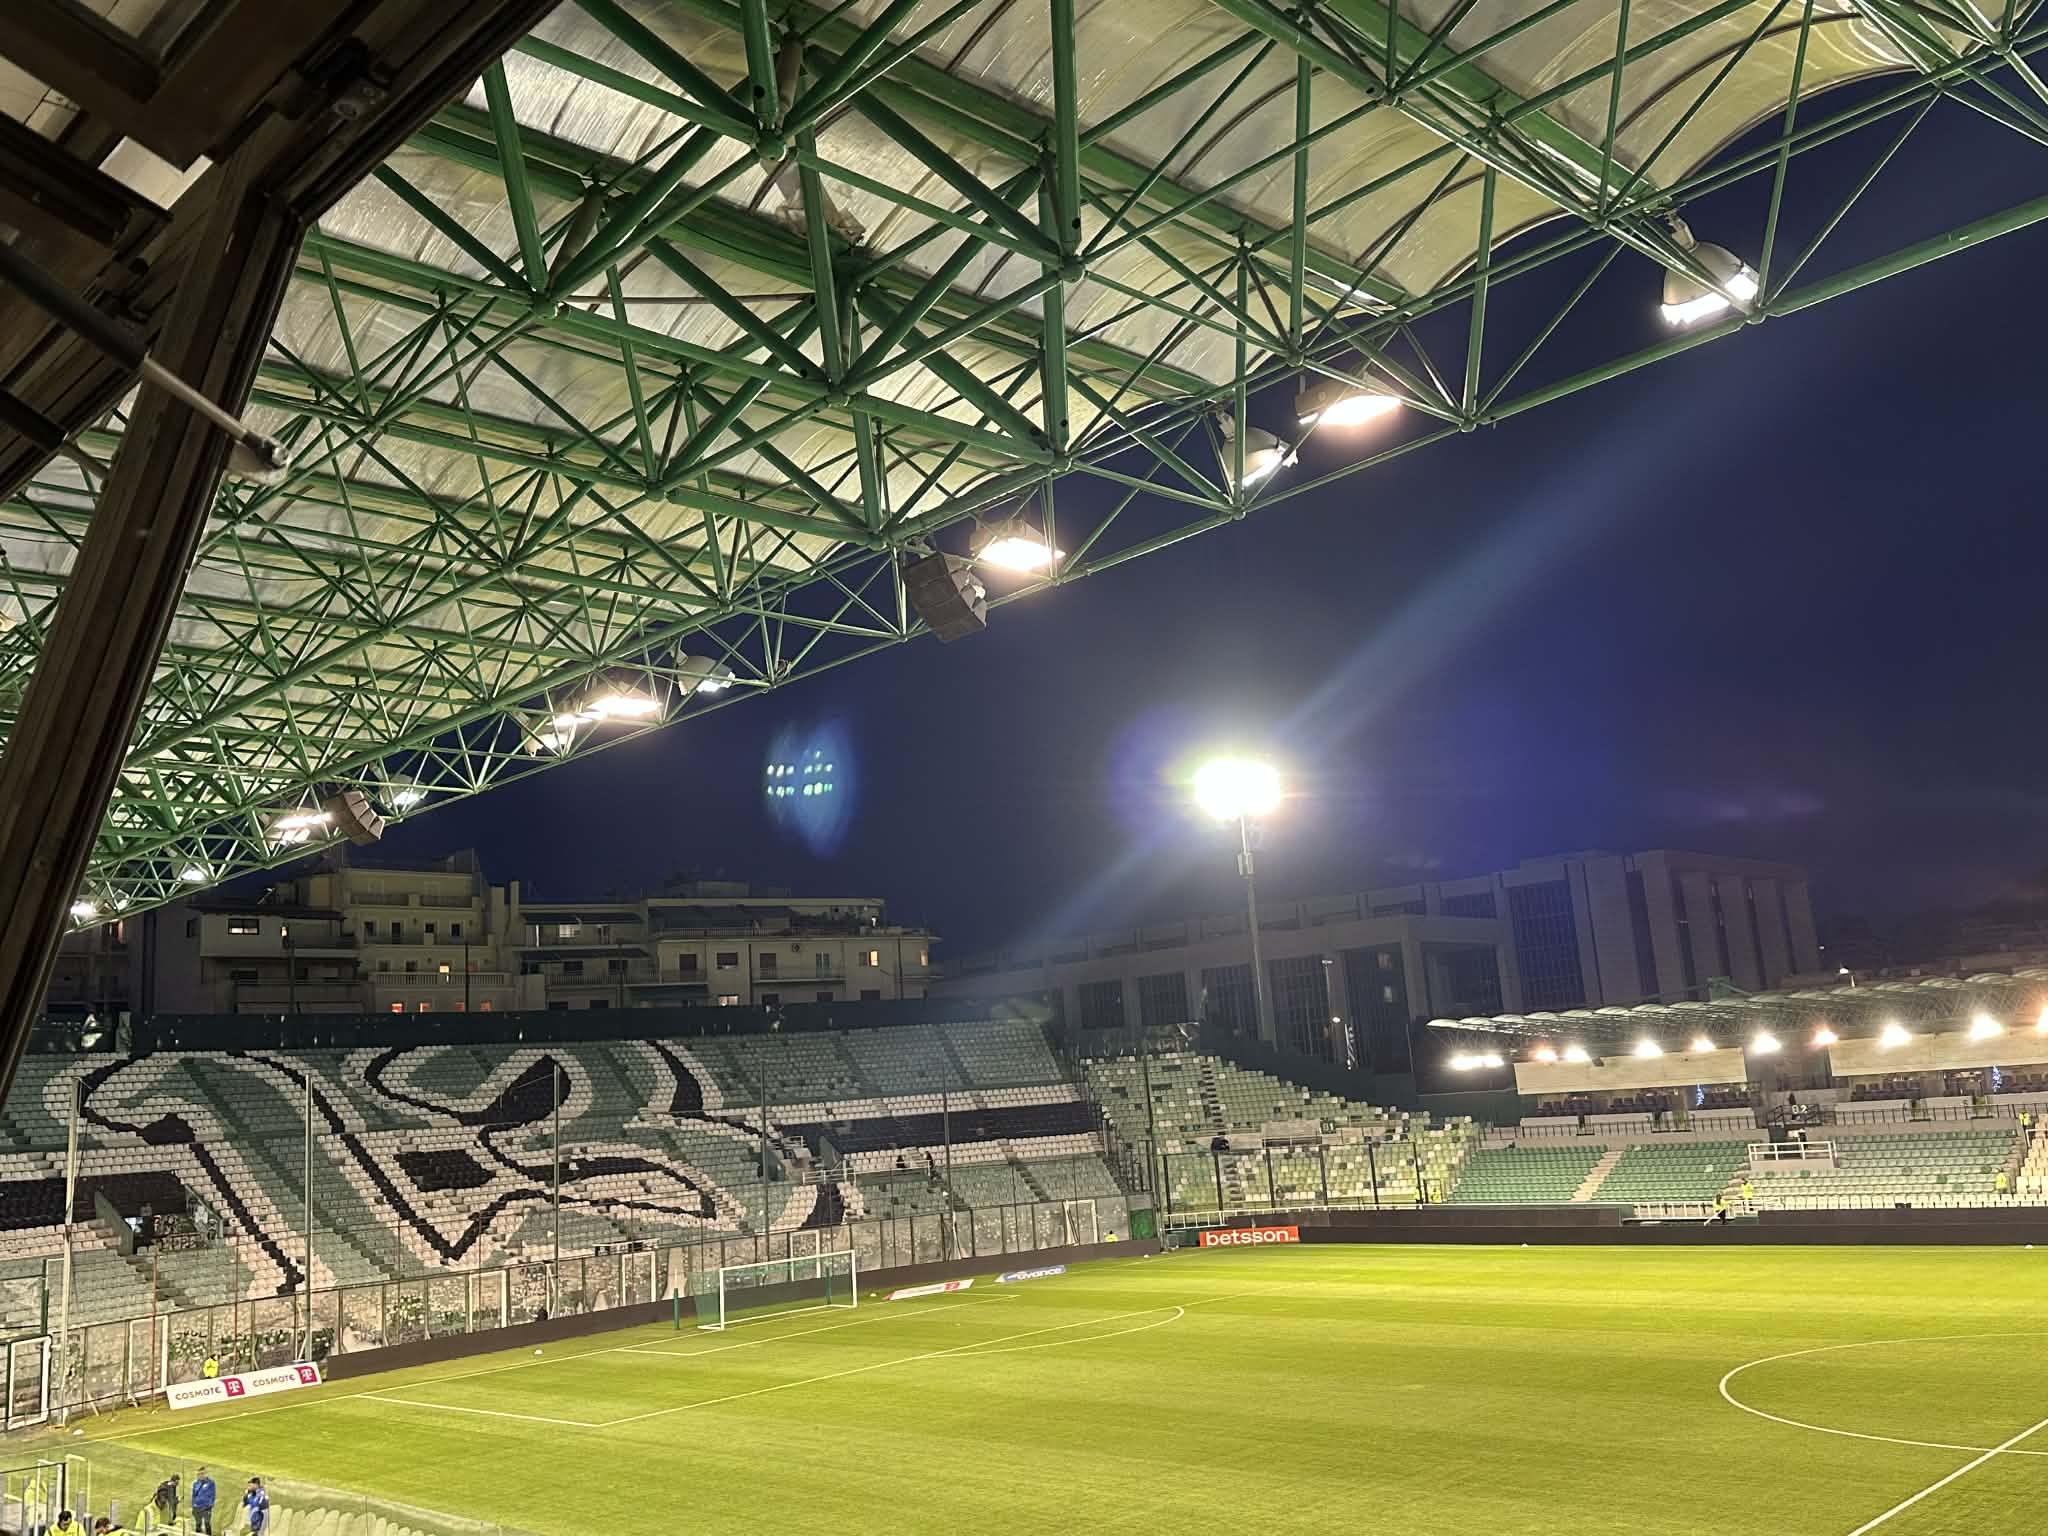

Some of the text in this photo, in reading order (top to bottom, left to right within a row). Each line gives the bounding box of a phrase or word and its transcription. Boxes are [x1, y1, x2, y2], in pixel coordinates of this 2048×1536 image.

[1206, 1230, 1288, 1246] betsson
[175, 1386, 221, 1401] COSMOTE
[252, 1374, 296, 1387] COSMOTE
